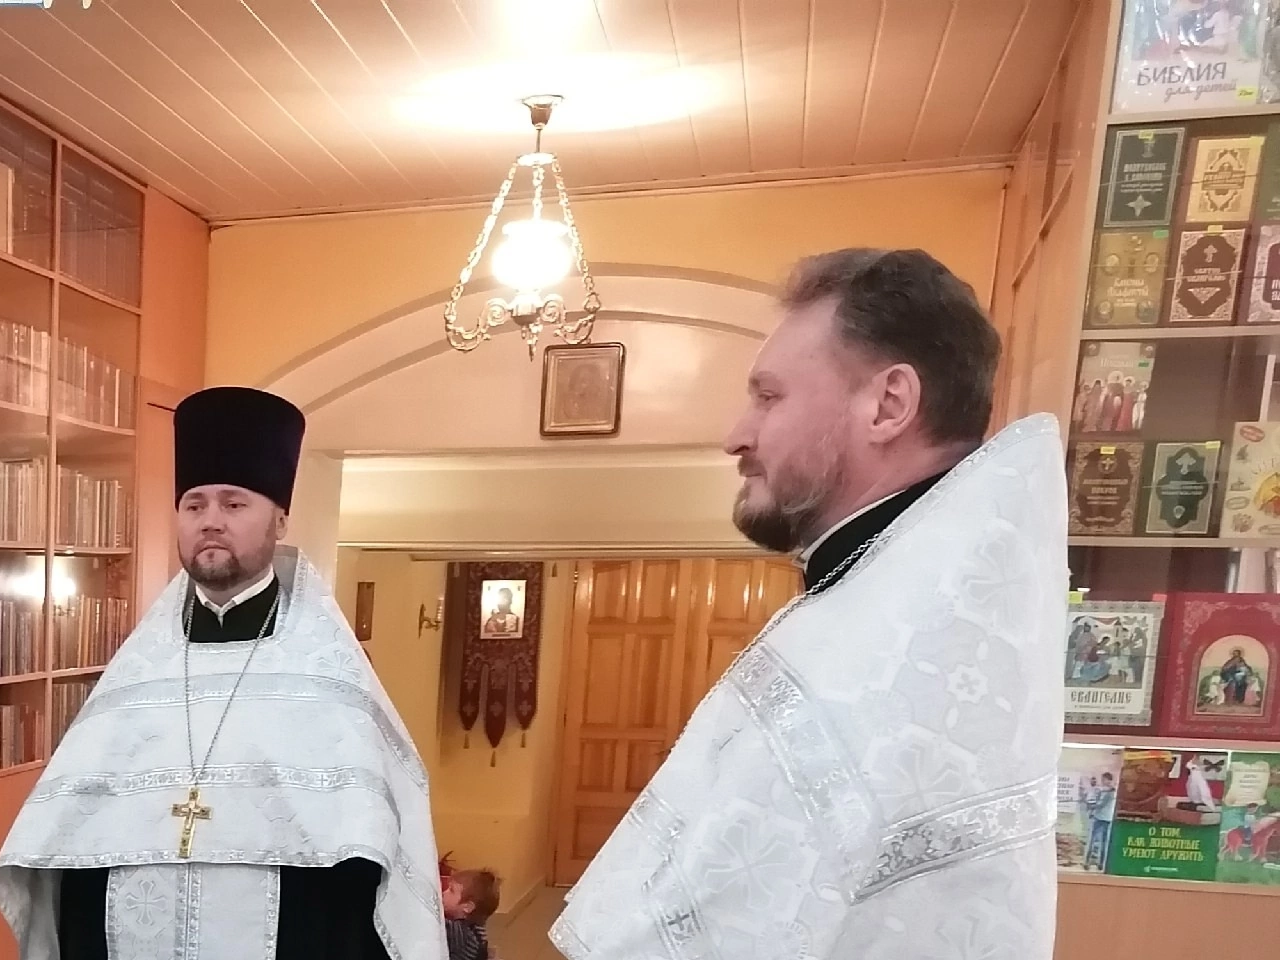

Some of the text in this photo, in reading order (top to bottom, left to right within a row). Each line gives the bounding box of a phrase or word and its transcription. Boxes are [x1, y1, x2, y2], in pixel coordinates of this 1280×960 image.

[1137, 62, 1227, 86] БИБЛИЯ
[1194, 79, 1237, 101] детей
[1148, 826, 1156, 836] О
[1127, 836, 1200, 850] КАК ЖИВОТНЫЕ
[1122, 847, 1204, 861] УМЕЮТ ДРУЖИТЬ
